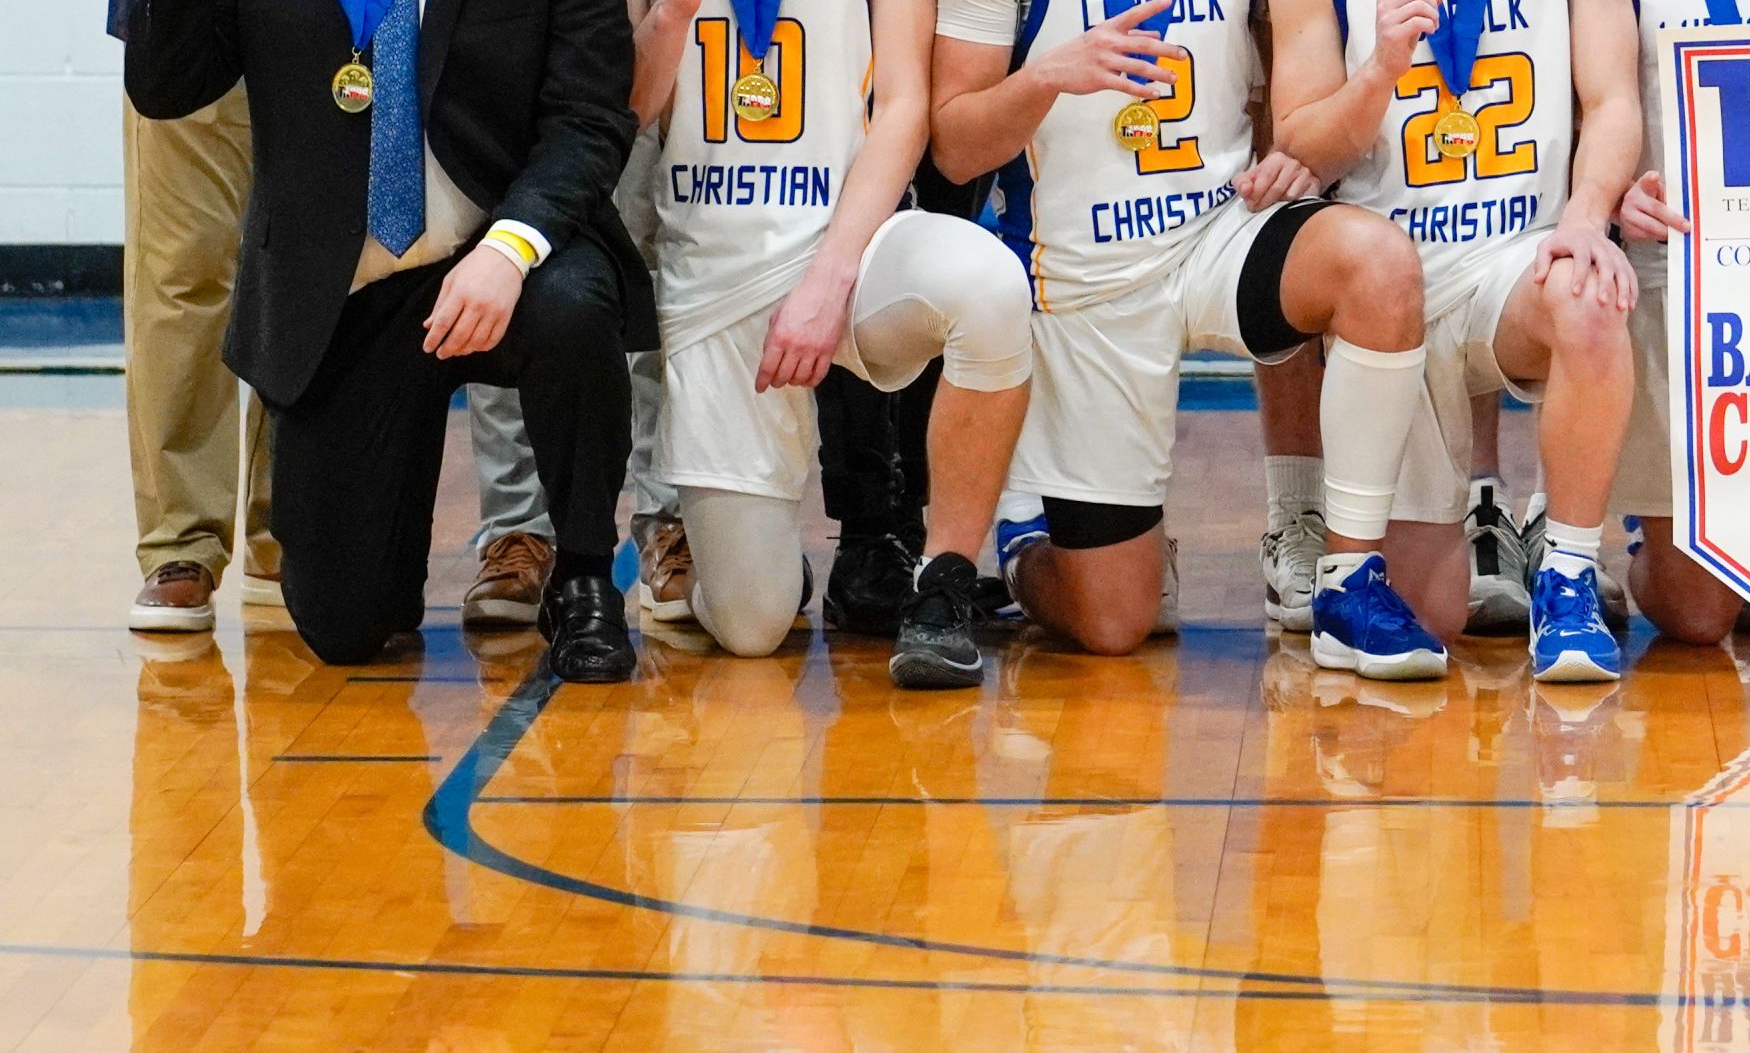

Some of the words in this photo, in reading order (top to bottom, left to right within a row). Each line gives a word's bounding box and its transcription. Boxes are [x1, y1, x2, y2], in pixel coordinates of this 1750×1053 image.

[695, 17, 806, 144] 10
[1135, 45, 1206, 176] 2
[1395, 52, 1538, 188] 22
[671, 165, 830, 207] CHRISTIAN
